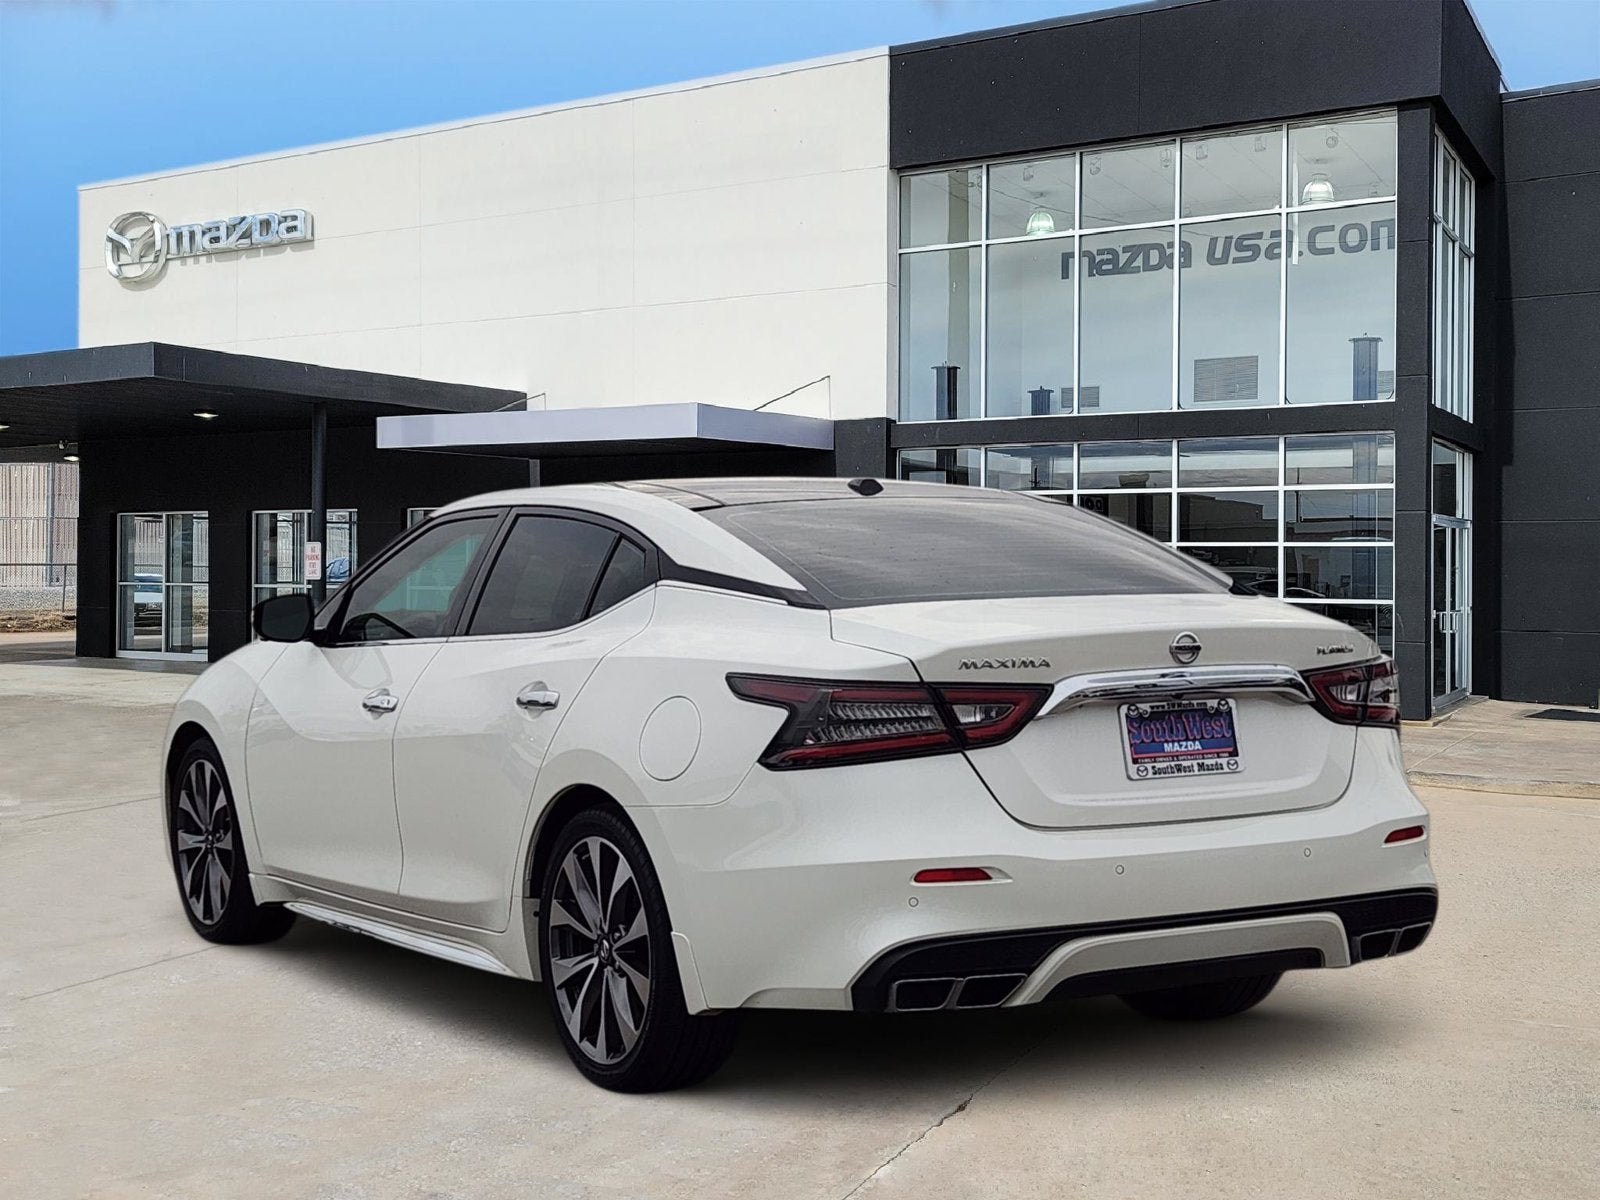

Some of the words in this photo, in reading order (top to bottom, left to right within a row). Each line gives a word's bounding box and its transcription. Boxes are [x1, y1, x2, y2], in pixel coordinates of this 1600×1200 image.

[166, 208, 314, 256] mazda
[1061, 239, 1192, 280] mazda
[958, 656, 1051, 670] MAXIMA
[1163, 740, 1202, 753] MAZDA
[1151, 763, 1195, 776] SouthWest
[1197, 760, 1225, 772] Mazda
